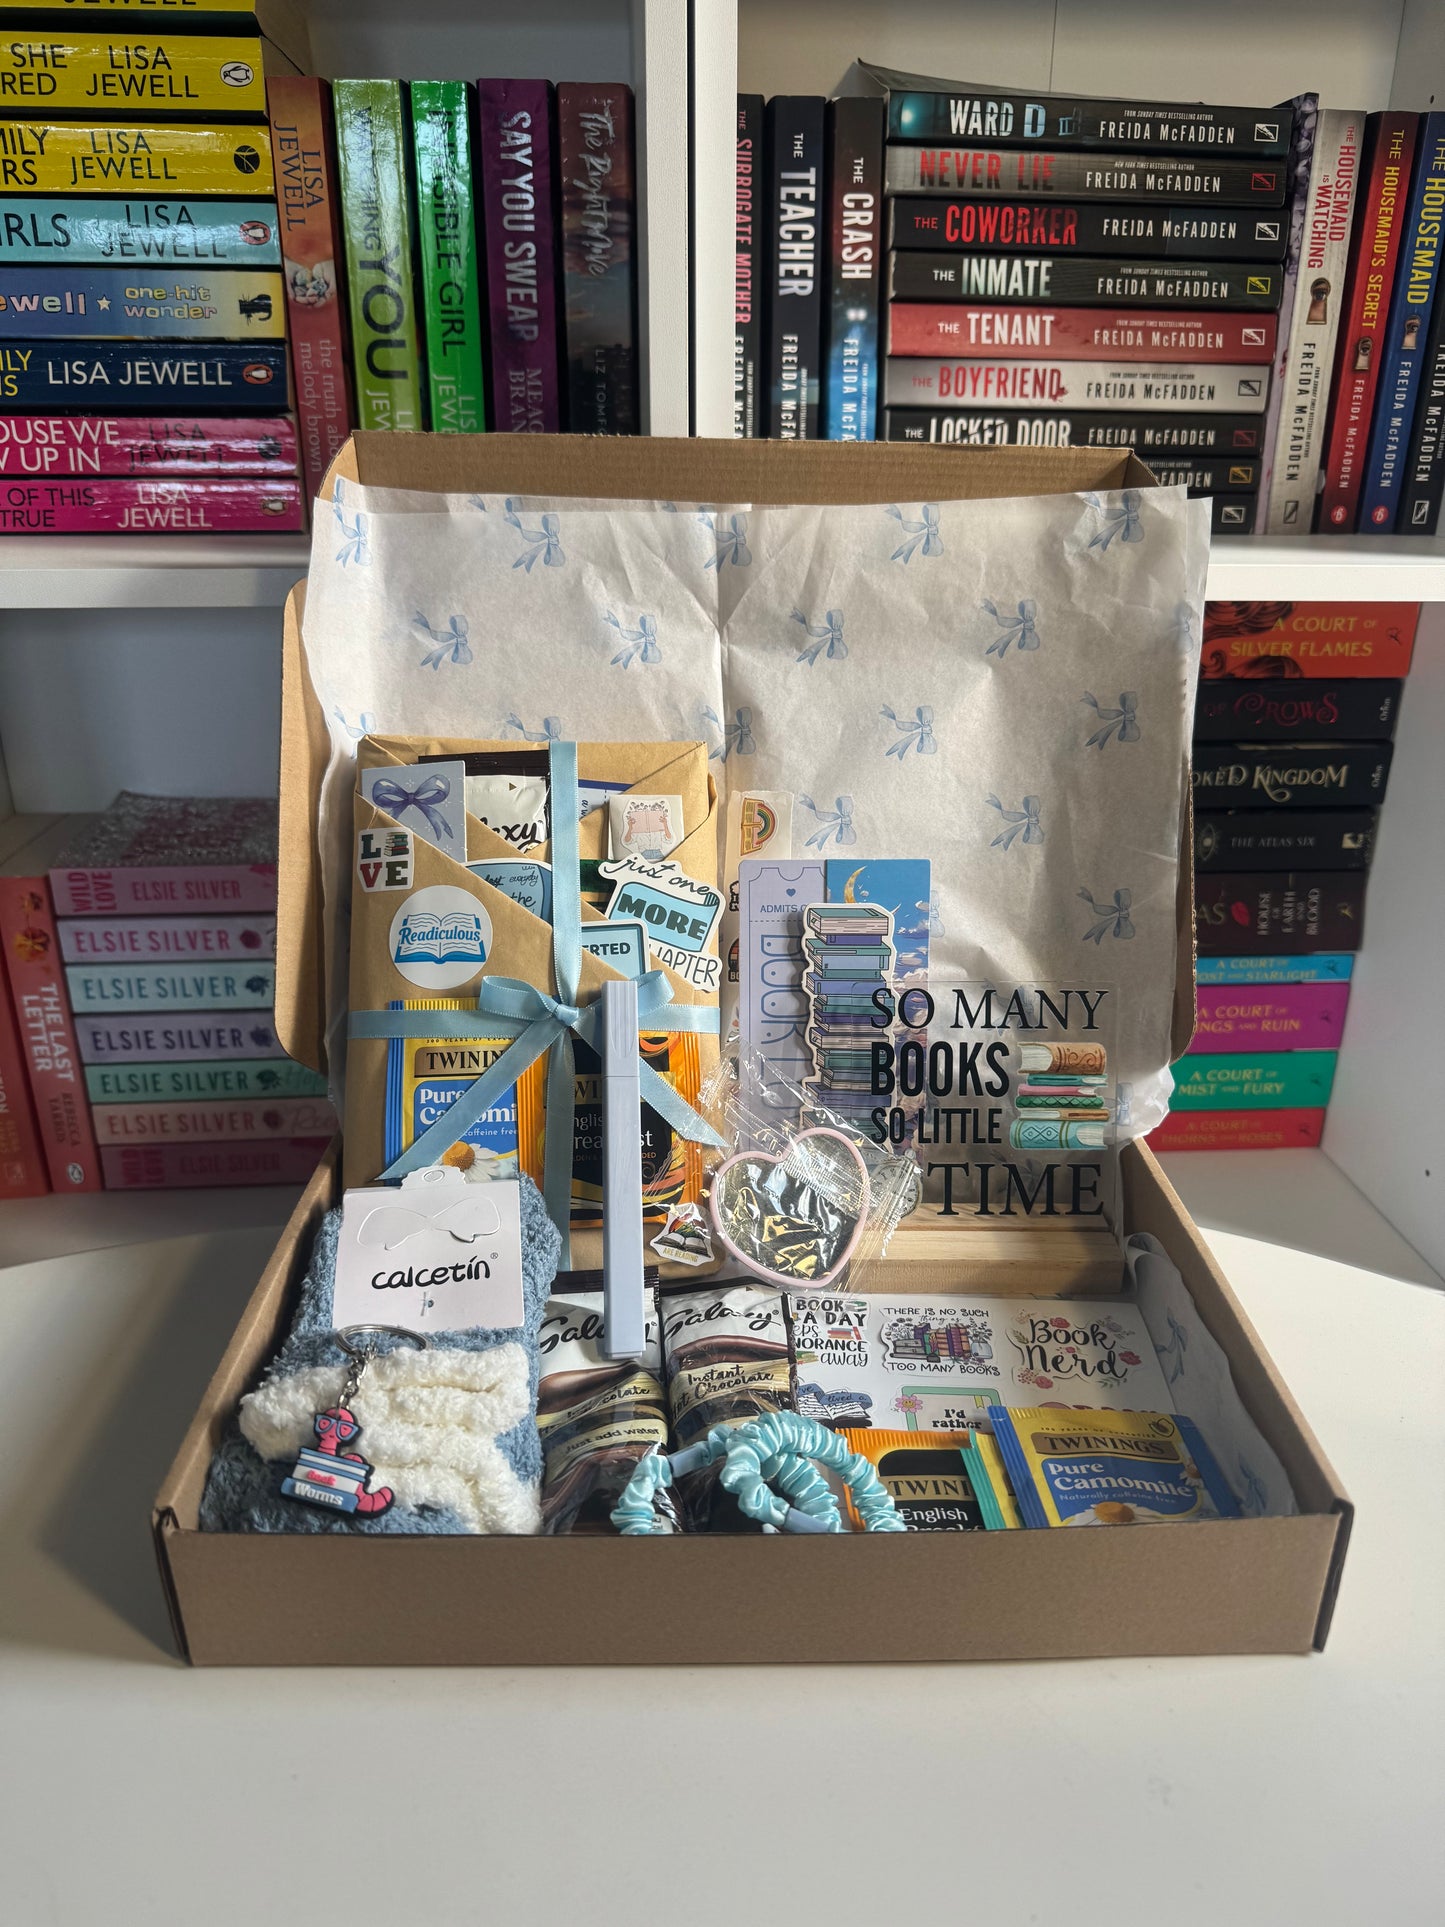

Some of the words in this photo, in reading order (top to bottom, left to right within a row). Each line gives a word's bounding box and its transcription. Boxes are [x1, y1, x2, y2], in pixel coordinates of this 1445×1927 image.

[11, 43, 69, 70] SHE
[108, 45, 173, 71] LISA
[86, 74, 200, 99] JEWELL
[579, 97, 616, 150] The
[950, 99, 1014, 137] WARD
[1023, 103, 1047, 138] D
[1099, 121, 1151, 140] FREIDA
[1159, 124, 1235, 144] McFADDEN
[1346, 126, 1357, 142] THE
[90, 131, 154, 155] LISA
[500, 110, 534, 168] SAY
[793, 132, 804, 158] THE
[1389, 130, 1405, 160] THE
[71, 156, 178, 186] JEWELL
[274, 120, 307, 232] JEWELL
[301, 150, 326, 209] LISA
[853, 157, 864, 184] THE
[920, 149, 1002, 189] NEVER
[1017, 154, 1057, 191] LIE
[1086, 172, 1137, 190] FREIDA
[1146, 175, 1221, 193] McFADDEN
[501, 172, 536, 232] YOU
[1328, 145, 1357, 242] HOUSEMAID
[779, 167, 816, 297] TEACHER
[914, 216, 938, 229] THE
[945, 205, 1079, 245] COWORKER
[1103, 219, 1154, 237] FREIDA
[1162, 220, 1237, 239] McFADDEN
[1307, 184, 1333, 269] WATCHING
[1372, 166, 1401, 267] HOUSEMAID'S
[842, 193, 874, 279] CRASH
[1407, 177, 1445, 304] HOUSEMAID
[124, 284, 212, 302] one-hit
[503, 241, 540, 342] SWEAR
[736, 253, 752, 324] MOTHER
[933, 270, 956, 282] THE
[961, 258, 1053, 297] INMATE
[1098, 278, 1148, 296] FREIDA
[1155, 280, 1229, 298] McFADDEN
[124, 302, 218, 320] wonder
[359, 244, 409, 380] YOU
[1362, 274, 1384, 330] SECRET
[439, 282, 467, 357] GIRL
[938, 322, 960, 334] THE
[967, 313, 1055, 346] TENANT
[1094, 330, 1143, 347] FREIDA
[1151, 332, 1224, 349] McFADDEN
[319, 338, 337, 369] the
[594, 348, 607, 375] LIZ
[781, 335, 799, 392] FREIDA
[843, 338, 860, 395] FREIDA
[1297, 342, 1316, 396] FREIDA
[48, 361, 111, 386] LISA
[119, 362, 233, 387] JEWELL
[300, 342, 322, 410] melody
[912, 376, 932, 388] THE
[938, 366, 1063, 399] BOYFRIEND
[1086, 382, 1136, 399] FREIDA
[1143, 384, 1216, 401] McFADDEN
[1393, 361, 1412, 410] FREIDA
[322, 374, 343, 419] truth
[1349, 379, 1365, 421] FREIDA
[68, 421, 120, 445] WE
[306, 415, 323, 473] brown
[904, 427, 924, 439] THE
[929, 417, 1009, 445] LOCKED
[1016, 419, 1072, 447] DOOR
[1088, 428, 1137, 445] FREIDA
[1144, 429, 1216, 446] McFADDEN
[1286, 405, 1308, 481] McFADDEN
[1415, 405, 1443, 482] McFADDEN
[20, 448, 60, 472] UP
[69, 448, 101, 472] IN
[1339, 428, 1358, 489] McFADDEN
[1380, 417, 1403, 488] McFADDEN
[7, 487, 40, 507] OF
[45, 487, 97, 507] THIS
[0, 510, 56, 529] TRUE
[117, 507, 214, 529] JEWELL
[1271, 617, 1286, 631] A
[1292, 616, 1358, 632] COURT
[1230, 641, 1296, 657] SILVER
[1298, 641, 1374, 657] FLAMES
[1252, 763, 1349, 803] KINGDOM
[67, 871, 93, 913] WILD
[92, 871, 117, 911] LOVE
[131, 881, 180, 901] ELSIE
[185, 880, 242, 900] SILVER
[667, 875, 711, 897] one
[616, 893, 708, 941] MORE
[759, 904, 798, 914] ADMITS
[73, 930, 142, 953] ELSIE
[147, 929, 231, 952] SILVER
[398, 925, 481, 946] Readiculous
[1230, 958, 1275, 969] COURT
[83, 977, 149, 1000] ELSIE
[156, 975, 237, 998] SILVER
[40, 982, 64, 1026] THE
[870, 987, 935, 1030] SO
[950, 988, 1109, 1031] MANY
[1215, 1004, 1273, 1018] COURT
[22, 994, 53, 1072] LETTER
[92, 1029, 156, 1051] ELSIE
[162, 1027, 244, 1049] SILVER
[1260, 1018, 1301, 1032] RUIN
[49, 1029, 75, 1083] LAST
[870, 1041, 1011, 1098] BOOKS
[101, 1073, 162, 1095] ELSIE
[172, 1070, 249, 1093] SILVER
[1178, 1083, 1217, 1096] MIST
[1242, 1082, 1286, 1096] FURY
[1206, 1068, 1263, 1082] COURT
[107, 1114, 171, 1137] ELSIE
[177, 1111, 256, 1134] SILVER
[870, 1107, 906, 1145] SO
[917, 1108, 1003, 1144] LITTLE
[926, 1161, 1105, 1216] TIME
[370, 1254, 491, 1291] calcetín
[796, 1299, 844, 1312] BOOK
[803, 1311, 818, 1325] A
[825, 1312, 867, 1327] DAY
[884, 1307, 921, 1316] THERE
[939, 1308, 957, 1316] NO
[961, 1308, 989, 1317] SUCH
[1029, 1317, 1116, 1350] Book
[687, 1364, 745, 1386] Instant
[820, 1352, 868, 1367] away
[888, 1361, 916, 1371] TOO
[920, 1362, 956, 1373] MANY
[959, 1364, 1001, 1377] BOOKS
[1024, 1343, 1128, 1379] Nerd
[694, 1371, 775, 1399] Chocolate
[595, 1429, 622, 1441] add
[623, 1427, 660, 1436] water
[1044, 1436, 1167, 1455] TWININGS
[1049, 1462, 1105, 1476] Pure
[294, 1481, 344, 1506] Worms
[1053, 1476, 1194, 1497] Camomile
[899, 1507, 969, 1524] English
